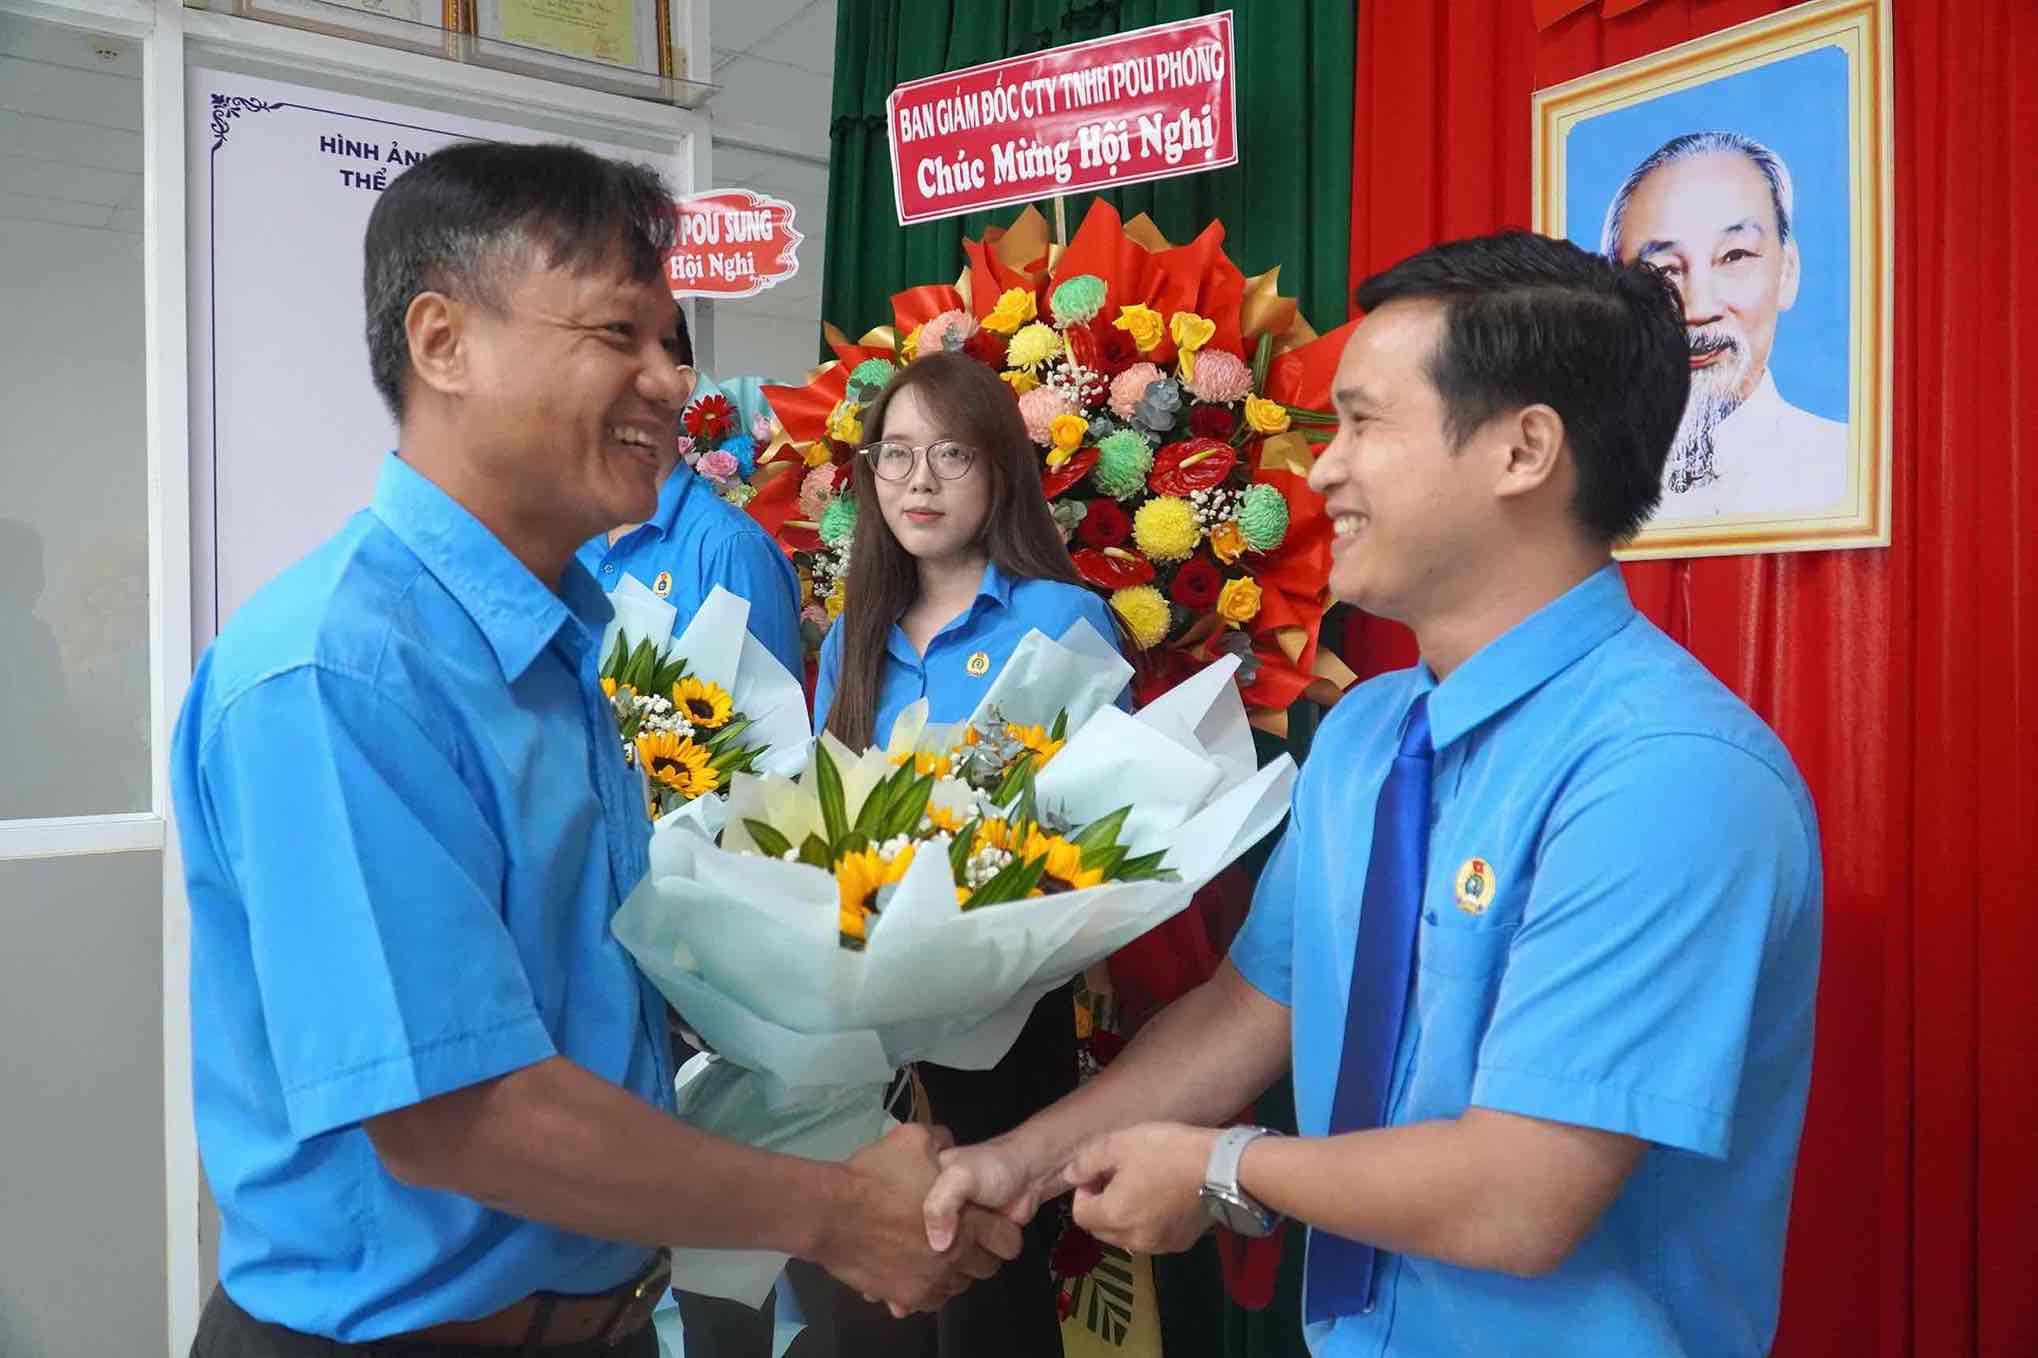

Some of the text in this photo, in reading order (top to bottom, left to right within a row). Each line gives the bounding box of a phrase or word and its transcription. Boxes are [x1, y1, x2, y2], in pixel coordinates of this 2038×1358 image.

[899, 42, 1225, 143] BAN GIÁM ĐỐC CTY TNHH POU PHONG
[320, 134, 429, 166] HÌNH ẢN
[917, 104, 1215, 198] Chúc Mừng Hội Nghị
[339, 167, 387, 191] THỂ
[680, 210, 721, 246] POU
[724, 209, 773, 244] SUNG
[670, 254, 704, 285] Hội
